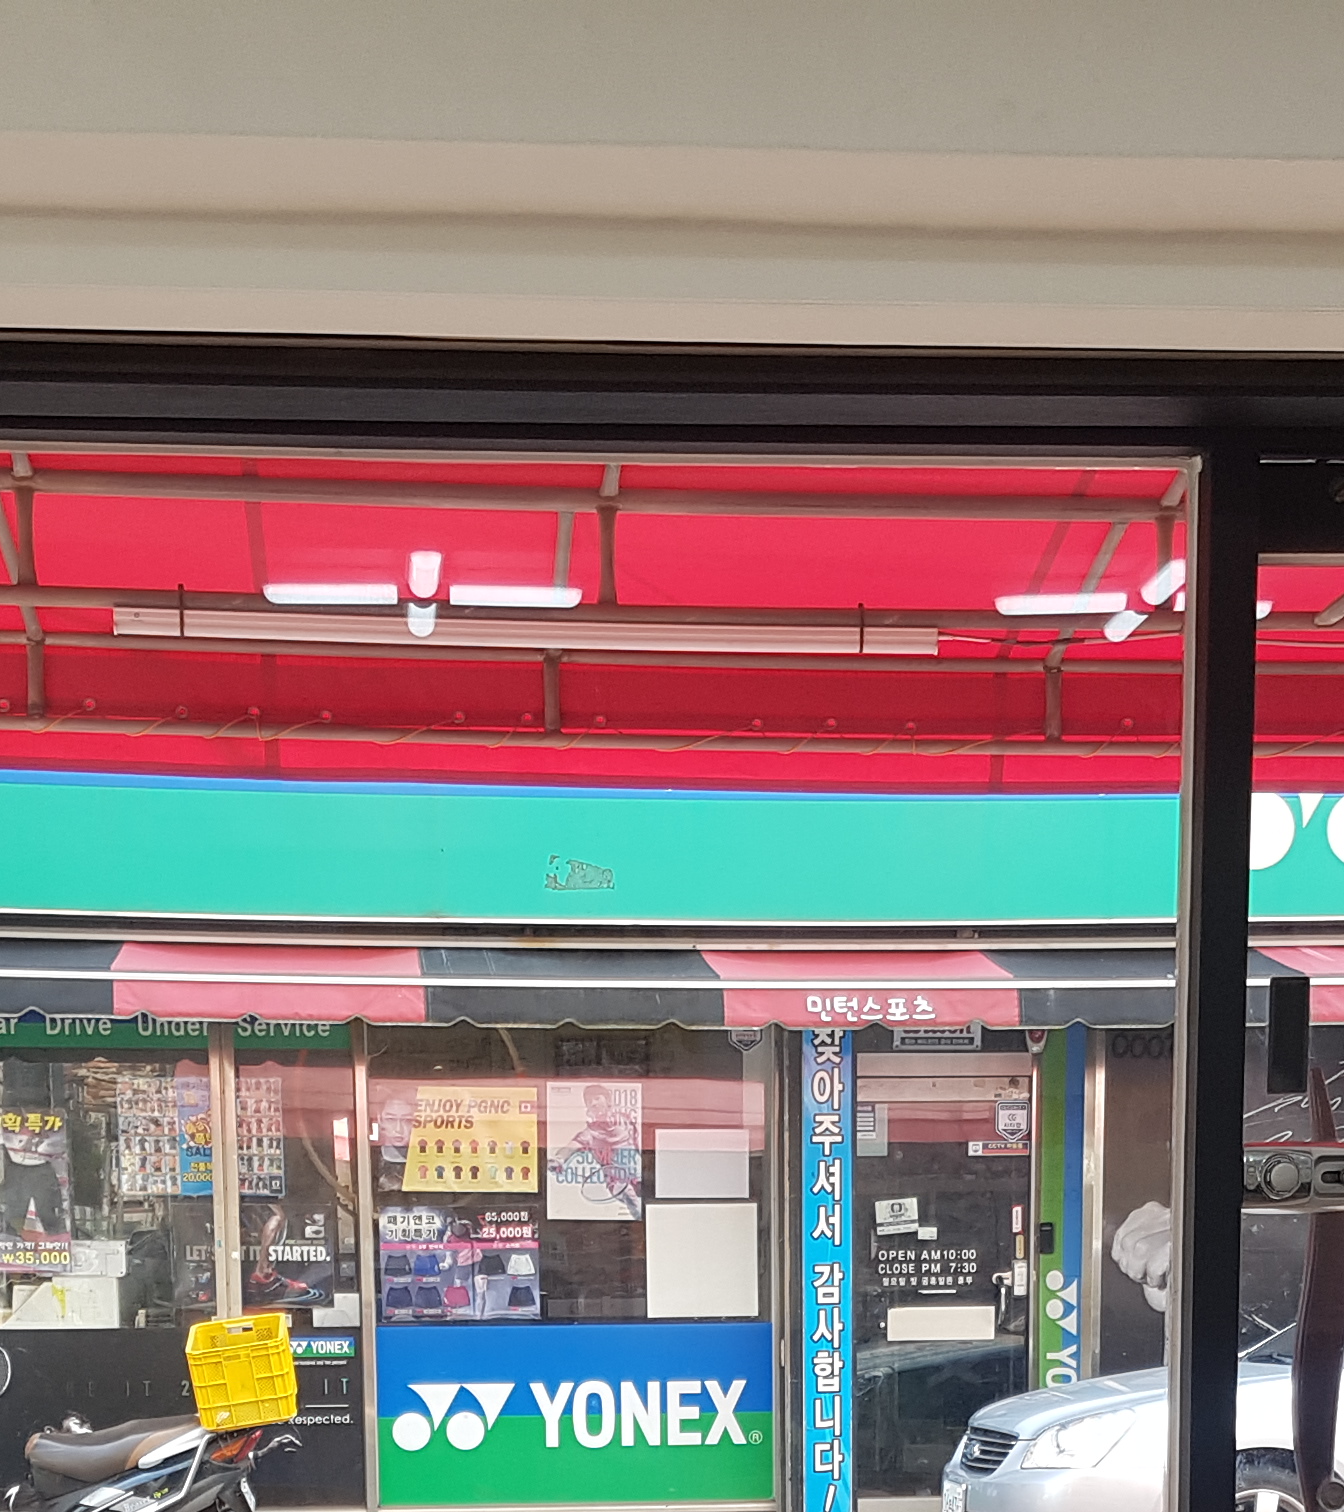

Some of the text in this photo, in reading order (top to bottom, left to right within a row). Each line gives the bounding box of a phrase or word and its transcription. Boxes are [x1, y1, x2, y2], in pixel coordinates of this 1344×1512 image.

[806, 995, 936, 1021] 민턴스포츠
[45, 1014, 113, 1037] Drive
[236, 1017, 331, 1038] Service
[414, 1097, 464, 1114] ENJOY
[412, 1114, 475, 1130] SPORTS
[268, 1245, 331, 1262] STARTED.
[878, 1249, 916, 1260] OPEN
[878, 1262, 977, 1274] CLOSE PM 7:30
[309, 1340, 351, 1354] YONEX
[528, 1379, 748, 1449] YONEX
